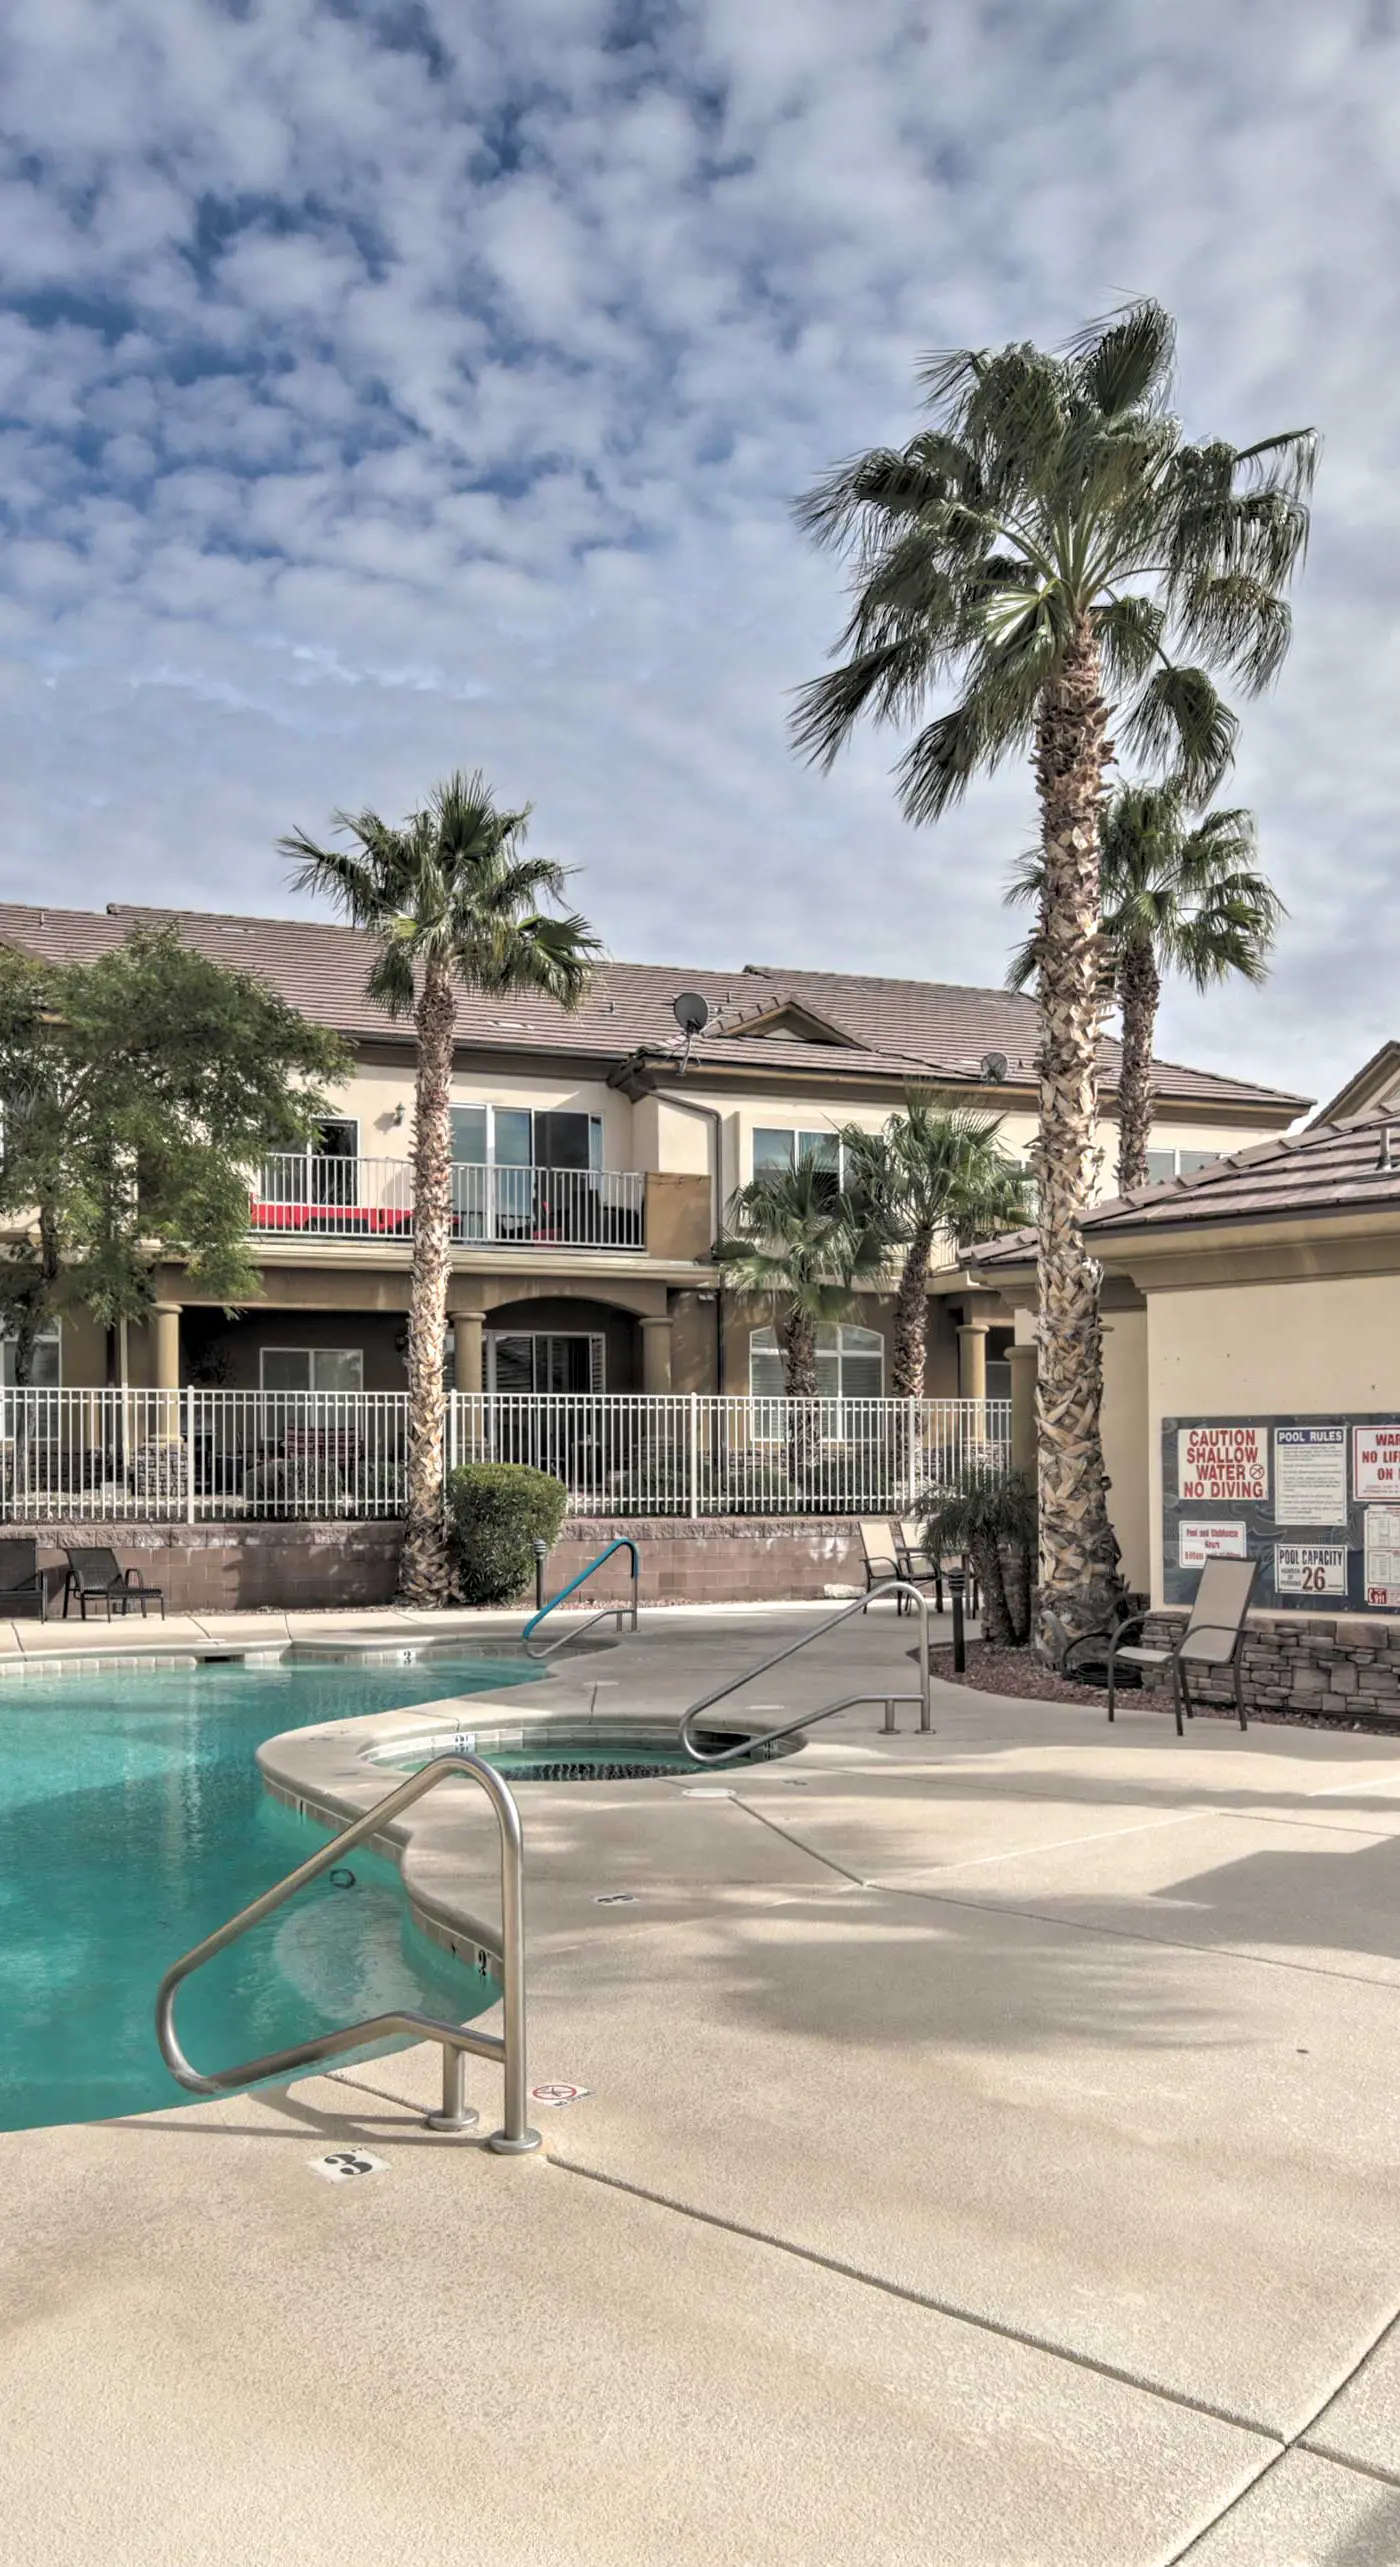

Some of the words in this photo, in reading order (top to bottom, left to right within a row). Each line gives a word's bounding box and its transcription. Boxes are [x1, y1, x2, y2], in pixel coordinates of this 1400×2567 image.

[1189, 1430, 1256, 1447] CAUTION
[1278, 1432, 1306, 1442] POOL
[1310, 1431, 1342, 1442] RULES
[1186, 1447, 1258, 1464] SHALLOW
[1362, 1450, 1378, 1463] NO
[1383, 1450, 1400, 1463] LIF
[1196, 1464, 1246, 1480] WATER
[1377, 1467, 1393, 1481] ON
[1183, 1481, 1205, 1498] NO
[1211, 1481, 1263, 1498] DIVING
[1279, 1549, 1300, 1565] POOL
[1302, 1550, 1343, 1566] CAPACITY
[1302, 1566, 1326, 1591] 26
